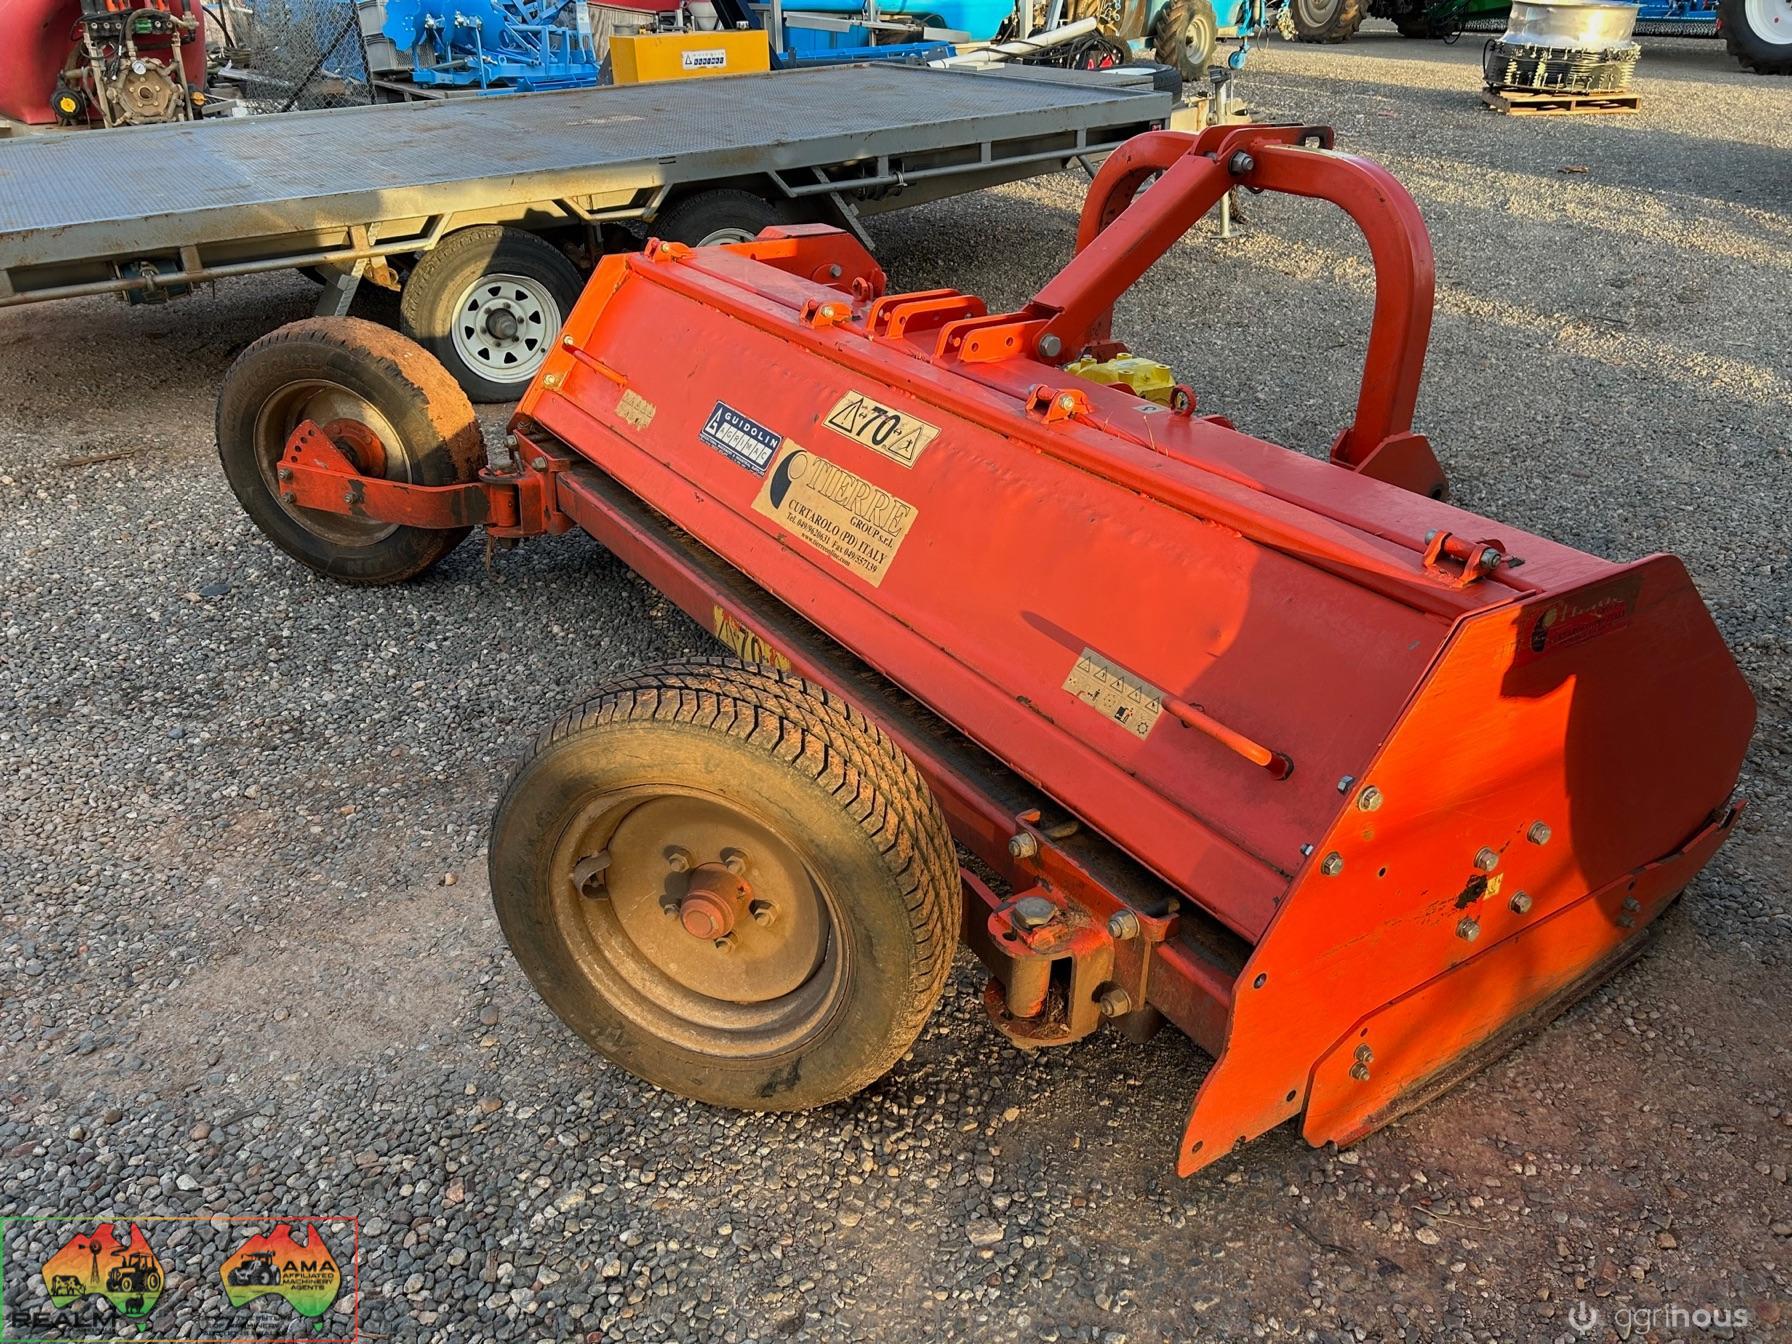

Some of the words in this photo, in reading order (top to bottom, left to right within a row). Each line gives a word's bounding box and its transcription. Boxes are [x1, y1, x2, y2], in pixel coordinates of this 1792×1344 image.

[719, 426, 768, 460] AGRIMAC
[724, 412, 778, 448] GUIDOLIN
[855, 405, 901, 446] 70
[806, 457, 911, 537] TIERRE
[788, 499, 840, 536] CURTAROLO
[840, 530, 858, 548] (PD)
[858, 540, 887, 564] ITALY
[850, 516, 880, 539] GROUP
[831, 540, 843, 553] Fax
